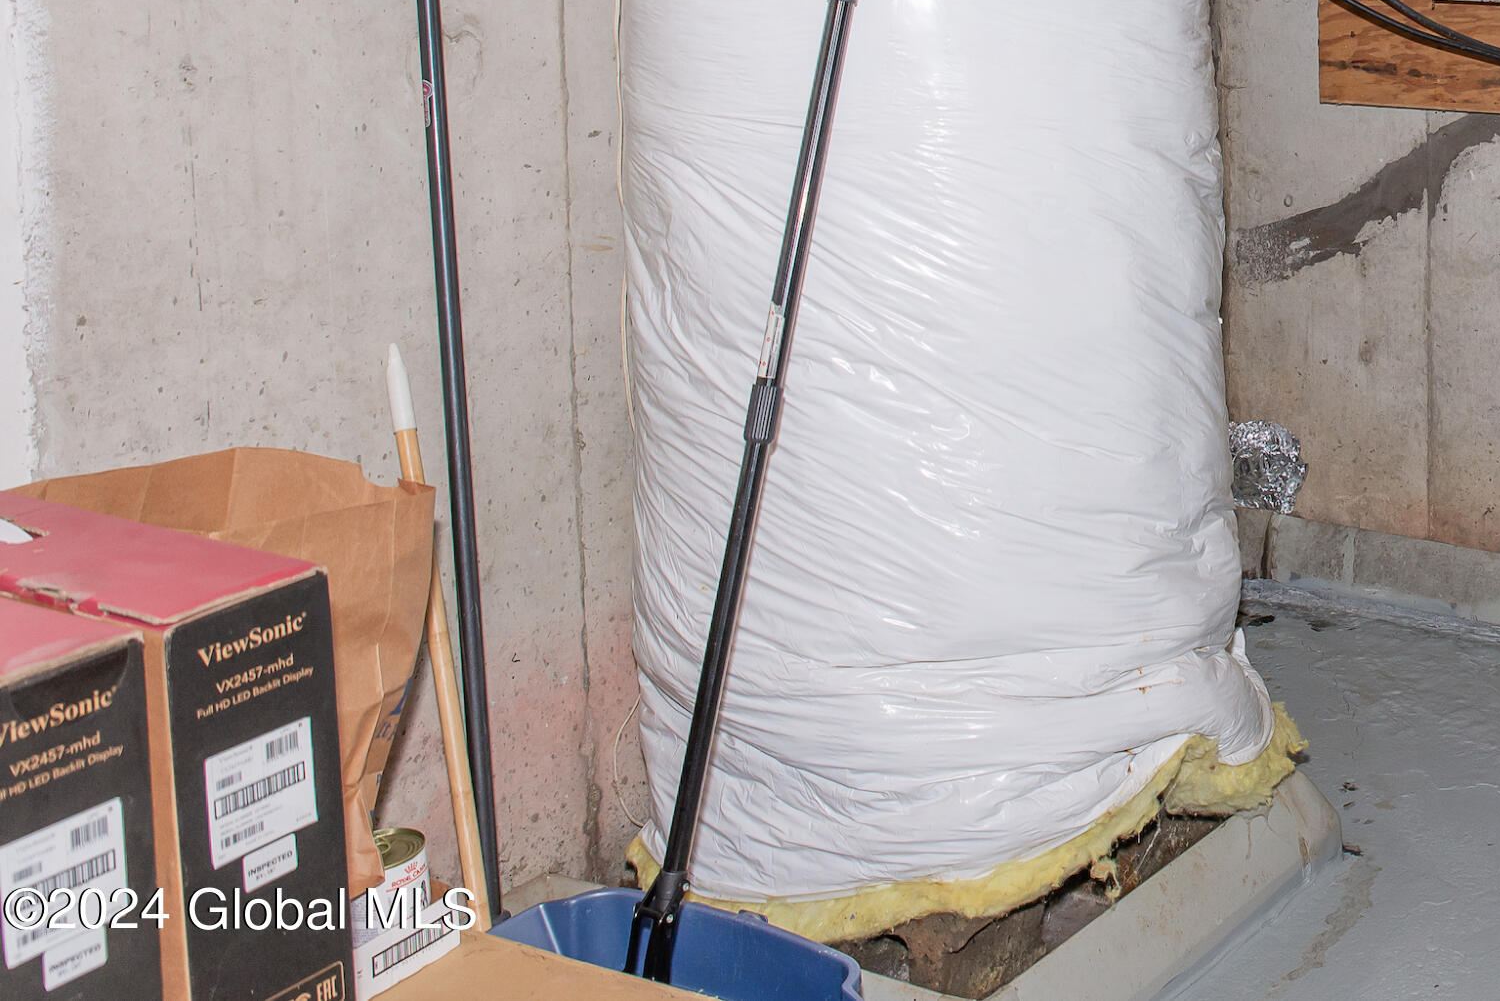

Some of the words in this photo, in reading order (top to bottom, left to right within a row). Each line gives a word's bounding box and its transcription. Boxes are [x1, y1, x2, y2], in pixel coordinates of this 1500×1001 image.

[197, 613, 304, 667] ViewSonic
[196, 704, 214, 720] Full
[215, 697, 231, 713] HD
[232, 690, 251, 706] LED
[252, 677, 281, 698] Backlit
[282, 666, 314, 686] Display
[215, 652, 294, 695] VX2457-mhd
[9, 729, 101, 777] VX2457-mhd
[9, 780, 26, 797] HD
[28, 771, 50, 790] LED
[247, 850, 293, 877] INSPECTED
